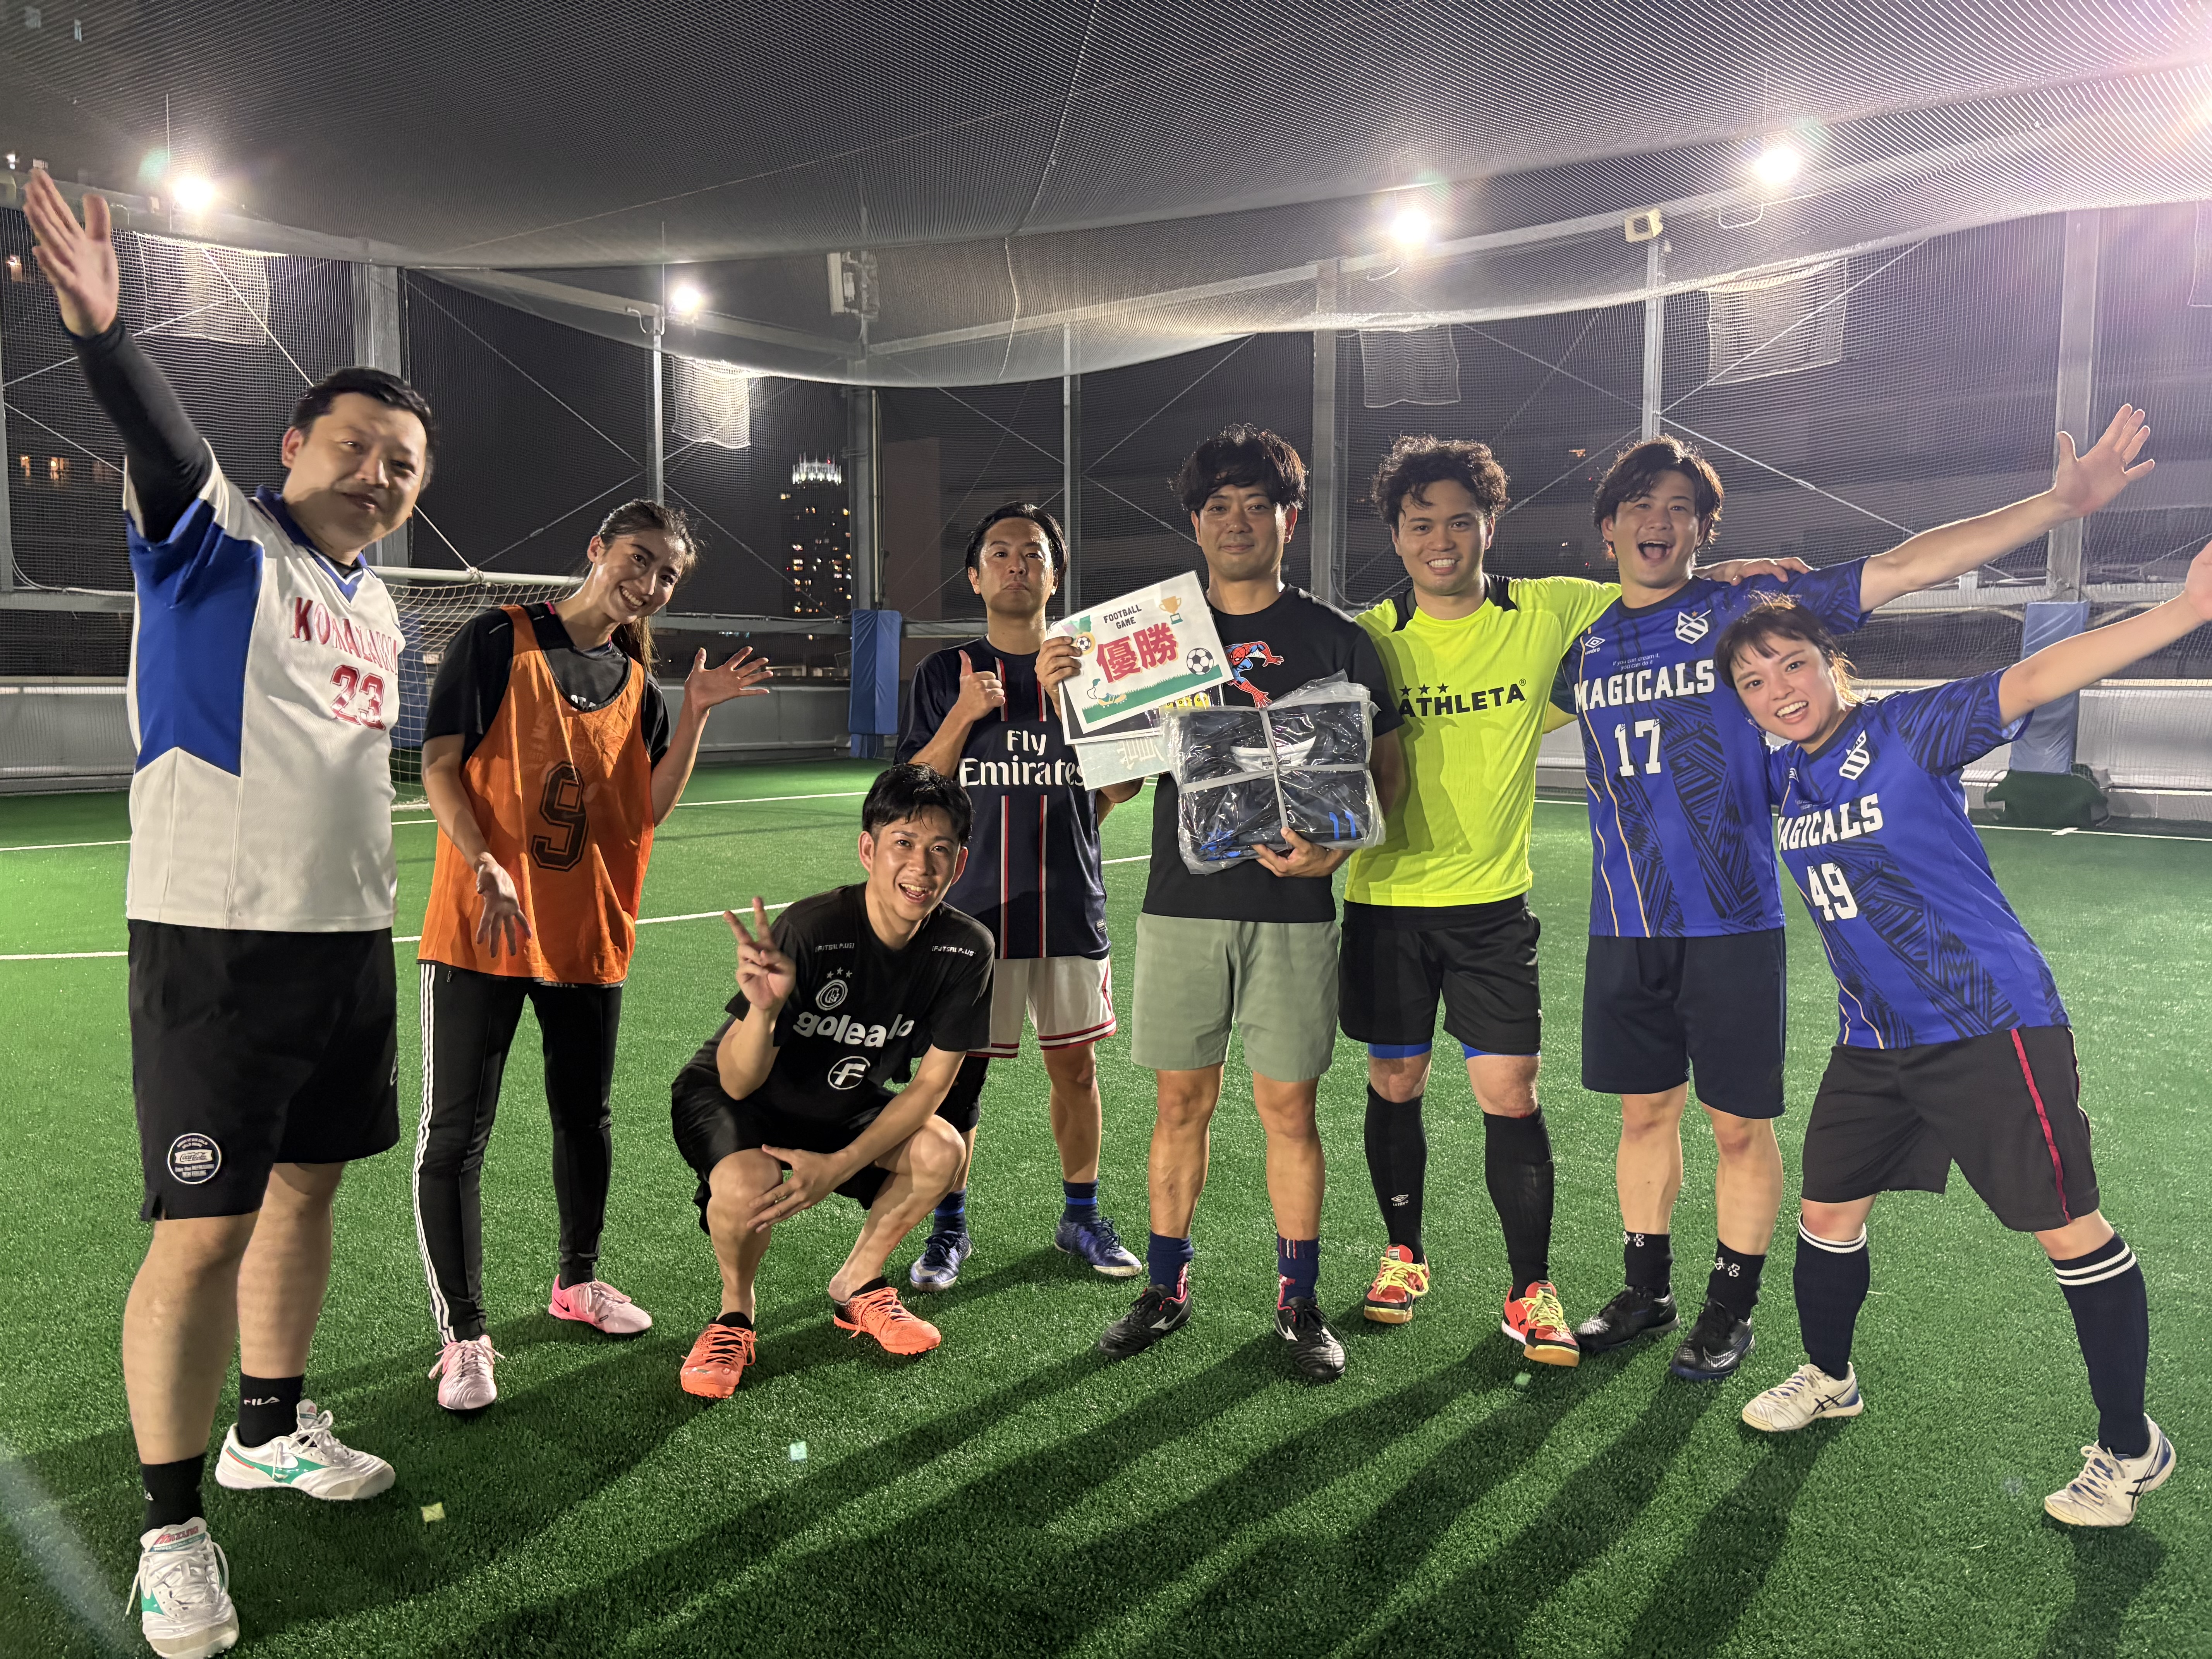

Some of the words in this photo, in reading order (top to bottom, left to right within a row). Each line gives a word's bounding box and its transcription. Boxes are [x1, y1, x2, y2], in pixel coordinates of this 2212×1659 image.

[1103, 604, 1142, 623] FOOTBALL
[1116, 616, 1136, 629] GAME
[1096, 622, 1178, 684] 優勝
[330, 665, 386, 731] 23
[1574, 659, 1715, 713] MAGICALS
[1007, 730, 1046, 756] Fly
[1614, 718, 1661, 777] 17
[959, 755, 1085, 787] Emirates
[531, 761, 589, 872] 9
[1807, 863, 1858, 921] 49
[244, 1396, 280, 1406] FILA
